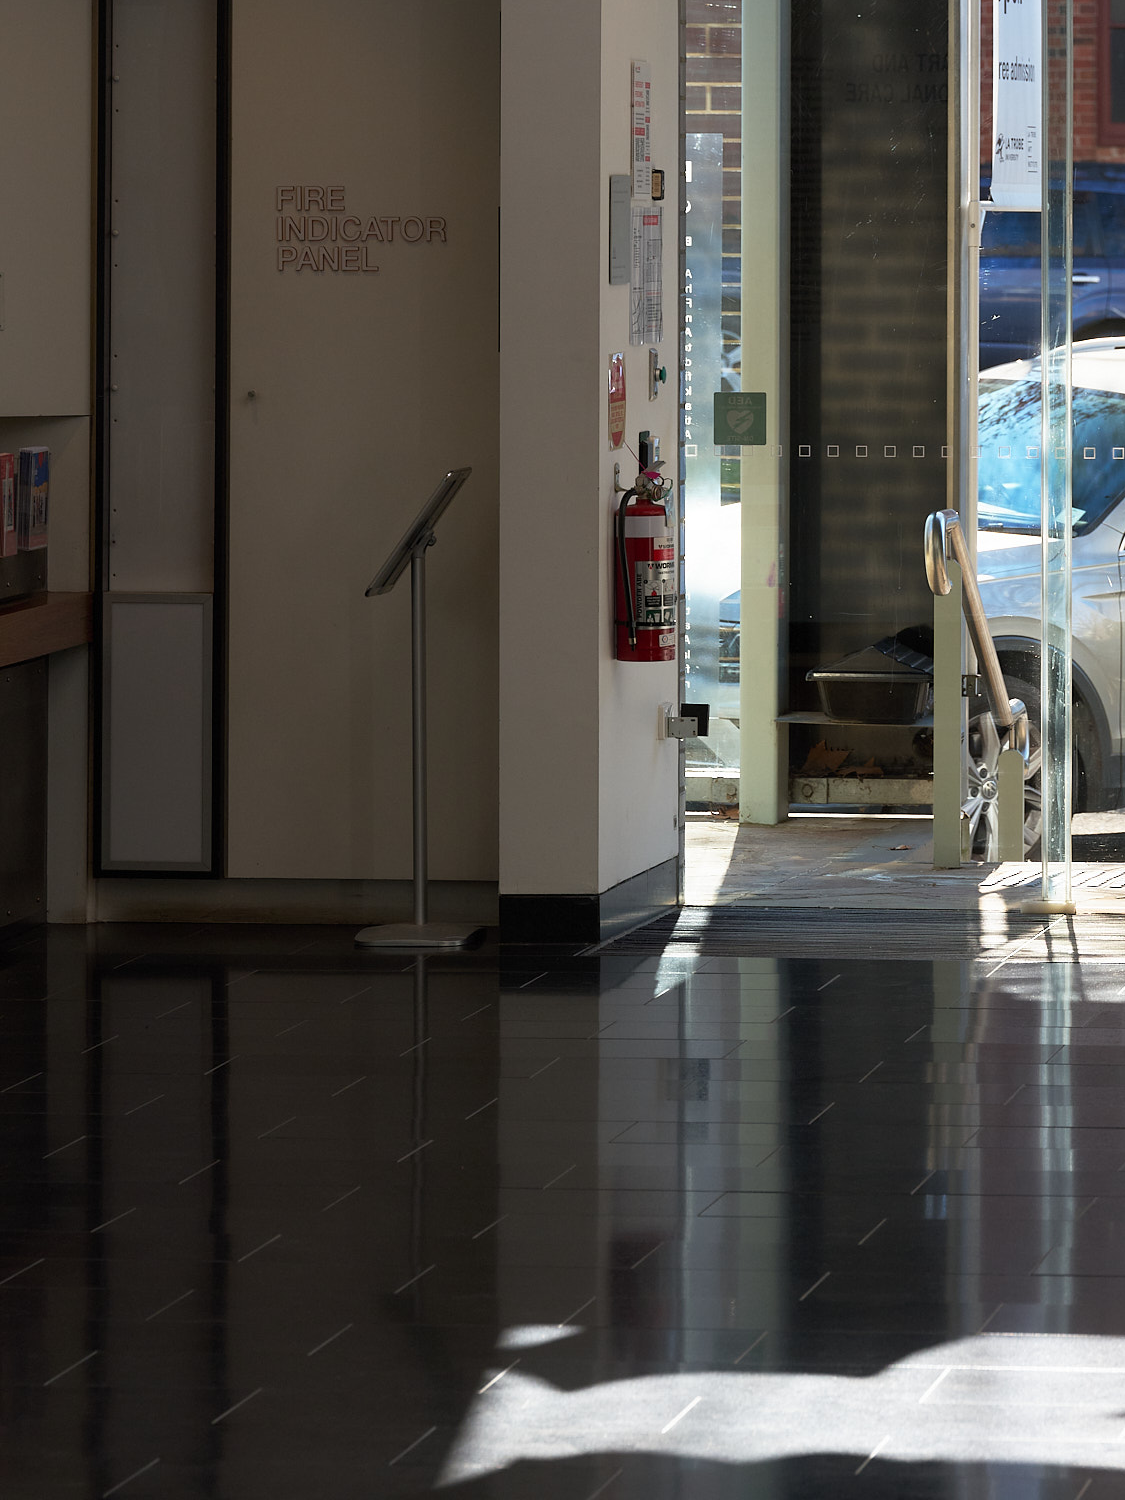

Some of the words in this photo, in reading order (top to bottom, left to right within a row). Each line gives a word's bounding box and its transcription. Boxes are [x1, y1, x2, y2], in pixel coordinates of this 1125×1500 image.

[276, 186, 345, 211] FIRE
[277, 216, 447, 242] INDICATOR
[278, 246, 379, 272] PANEL
